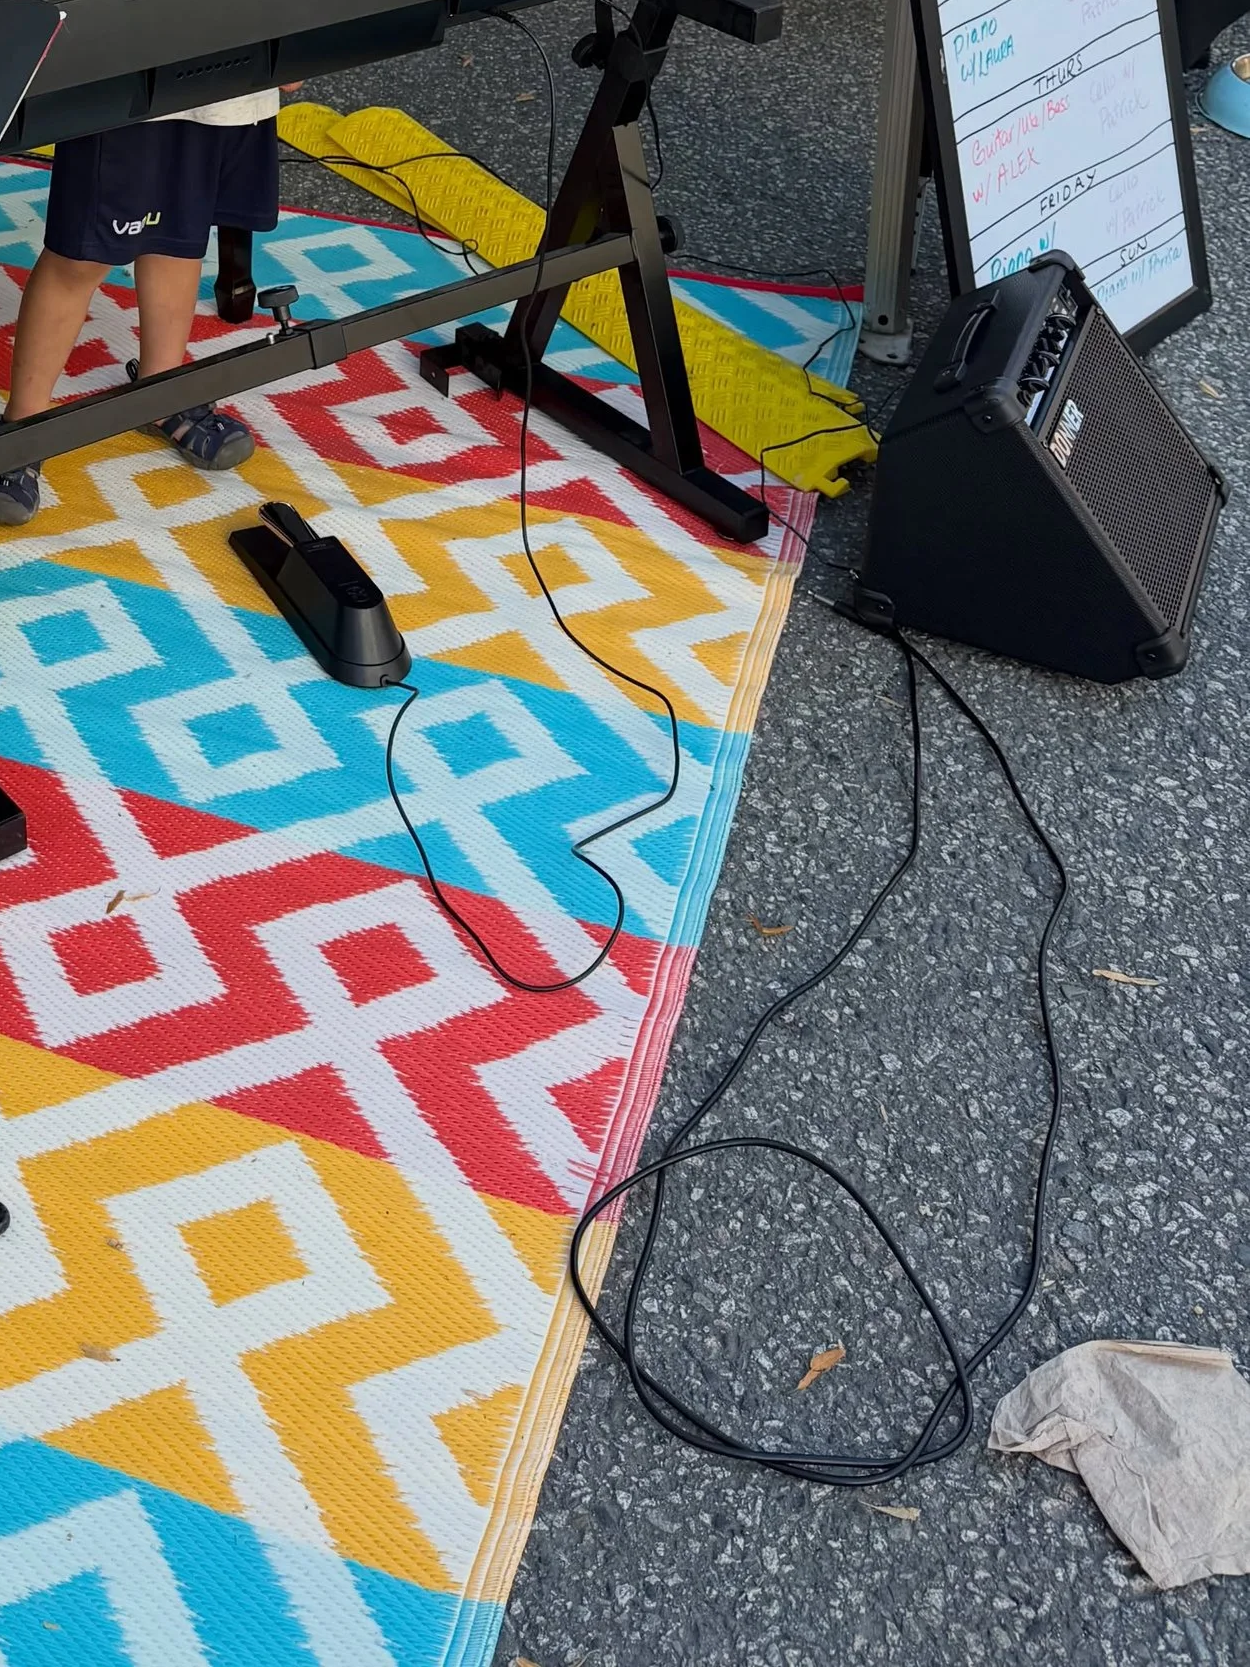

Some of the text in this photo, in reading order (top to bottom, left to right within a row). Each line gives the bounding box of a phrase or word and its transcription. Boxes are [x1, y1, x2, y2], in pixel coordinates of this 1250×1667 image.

[1033, 54, 1083, 95] THURS
[972, 146, 1041, 206] w/ ALEX
[1040, 168, 1098, 217] FRIDAY
[1119, 236, 1149, 268] SUN
[1050, 399, 1084, 470] DONNER
